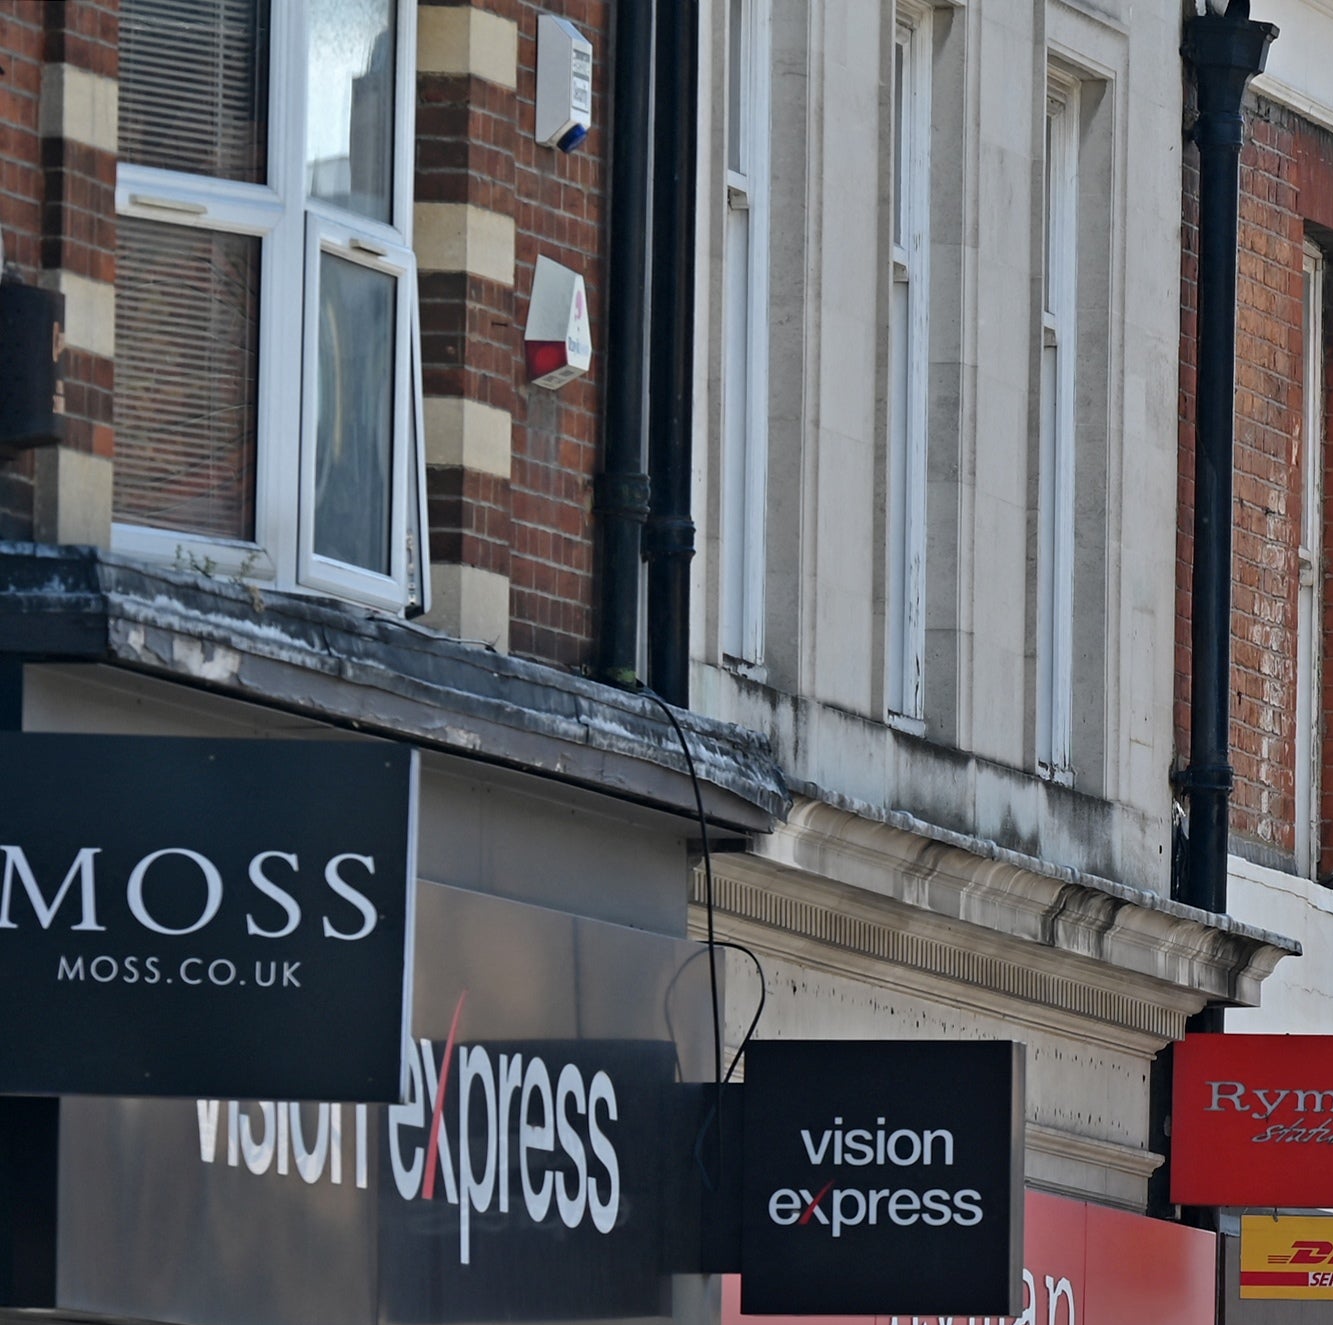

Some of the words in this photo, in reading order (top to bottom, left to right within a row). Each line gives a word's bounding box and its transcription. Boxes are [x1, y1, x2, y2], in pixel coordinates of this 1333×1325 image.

[0, 845, 379, 941] MOSS
[57, 955, 302, 988] MOSS.CO.UK
[388, 990, 620, 1264] express
[800, 1117, 954, 1167] vision
[768, 1181, 983, 1238] express
